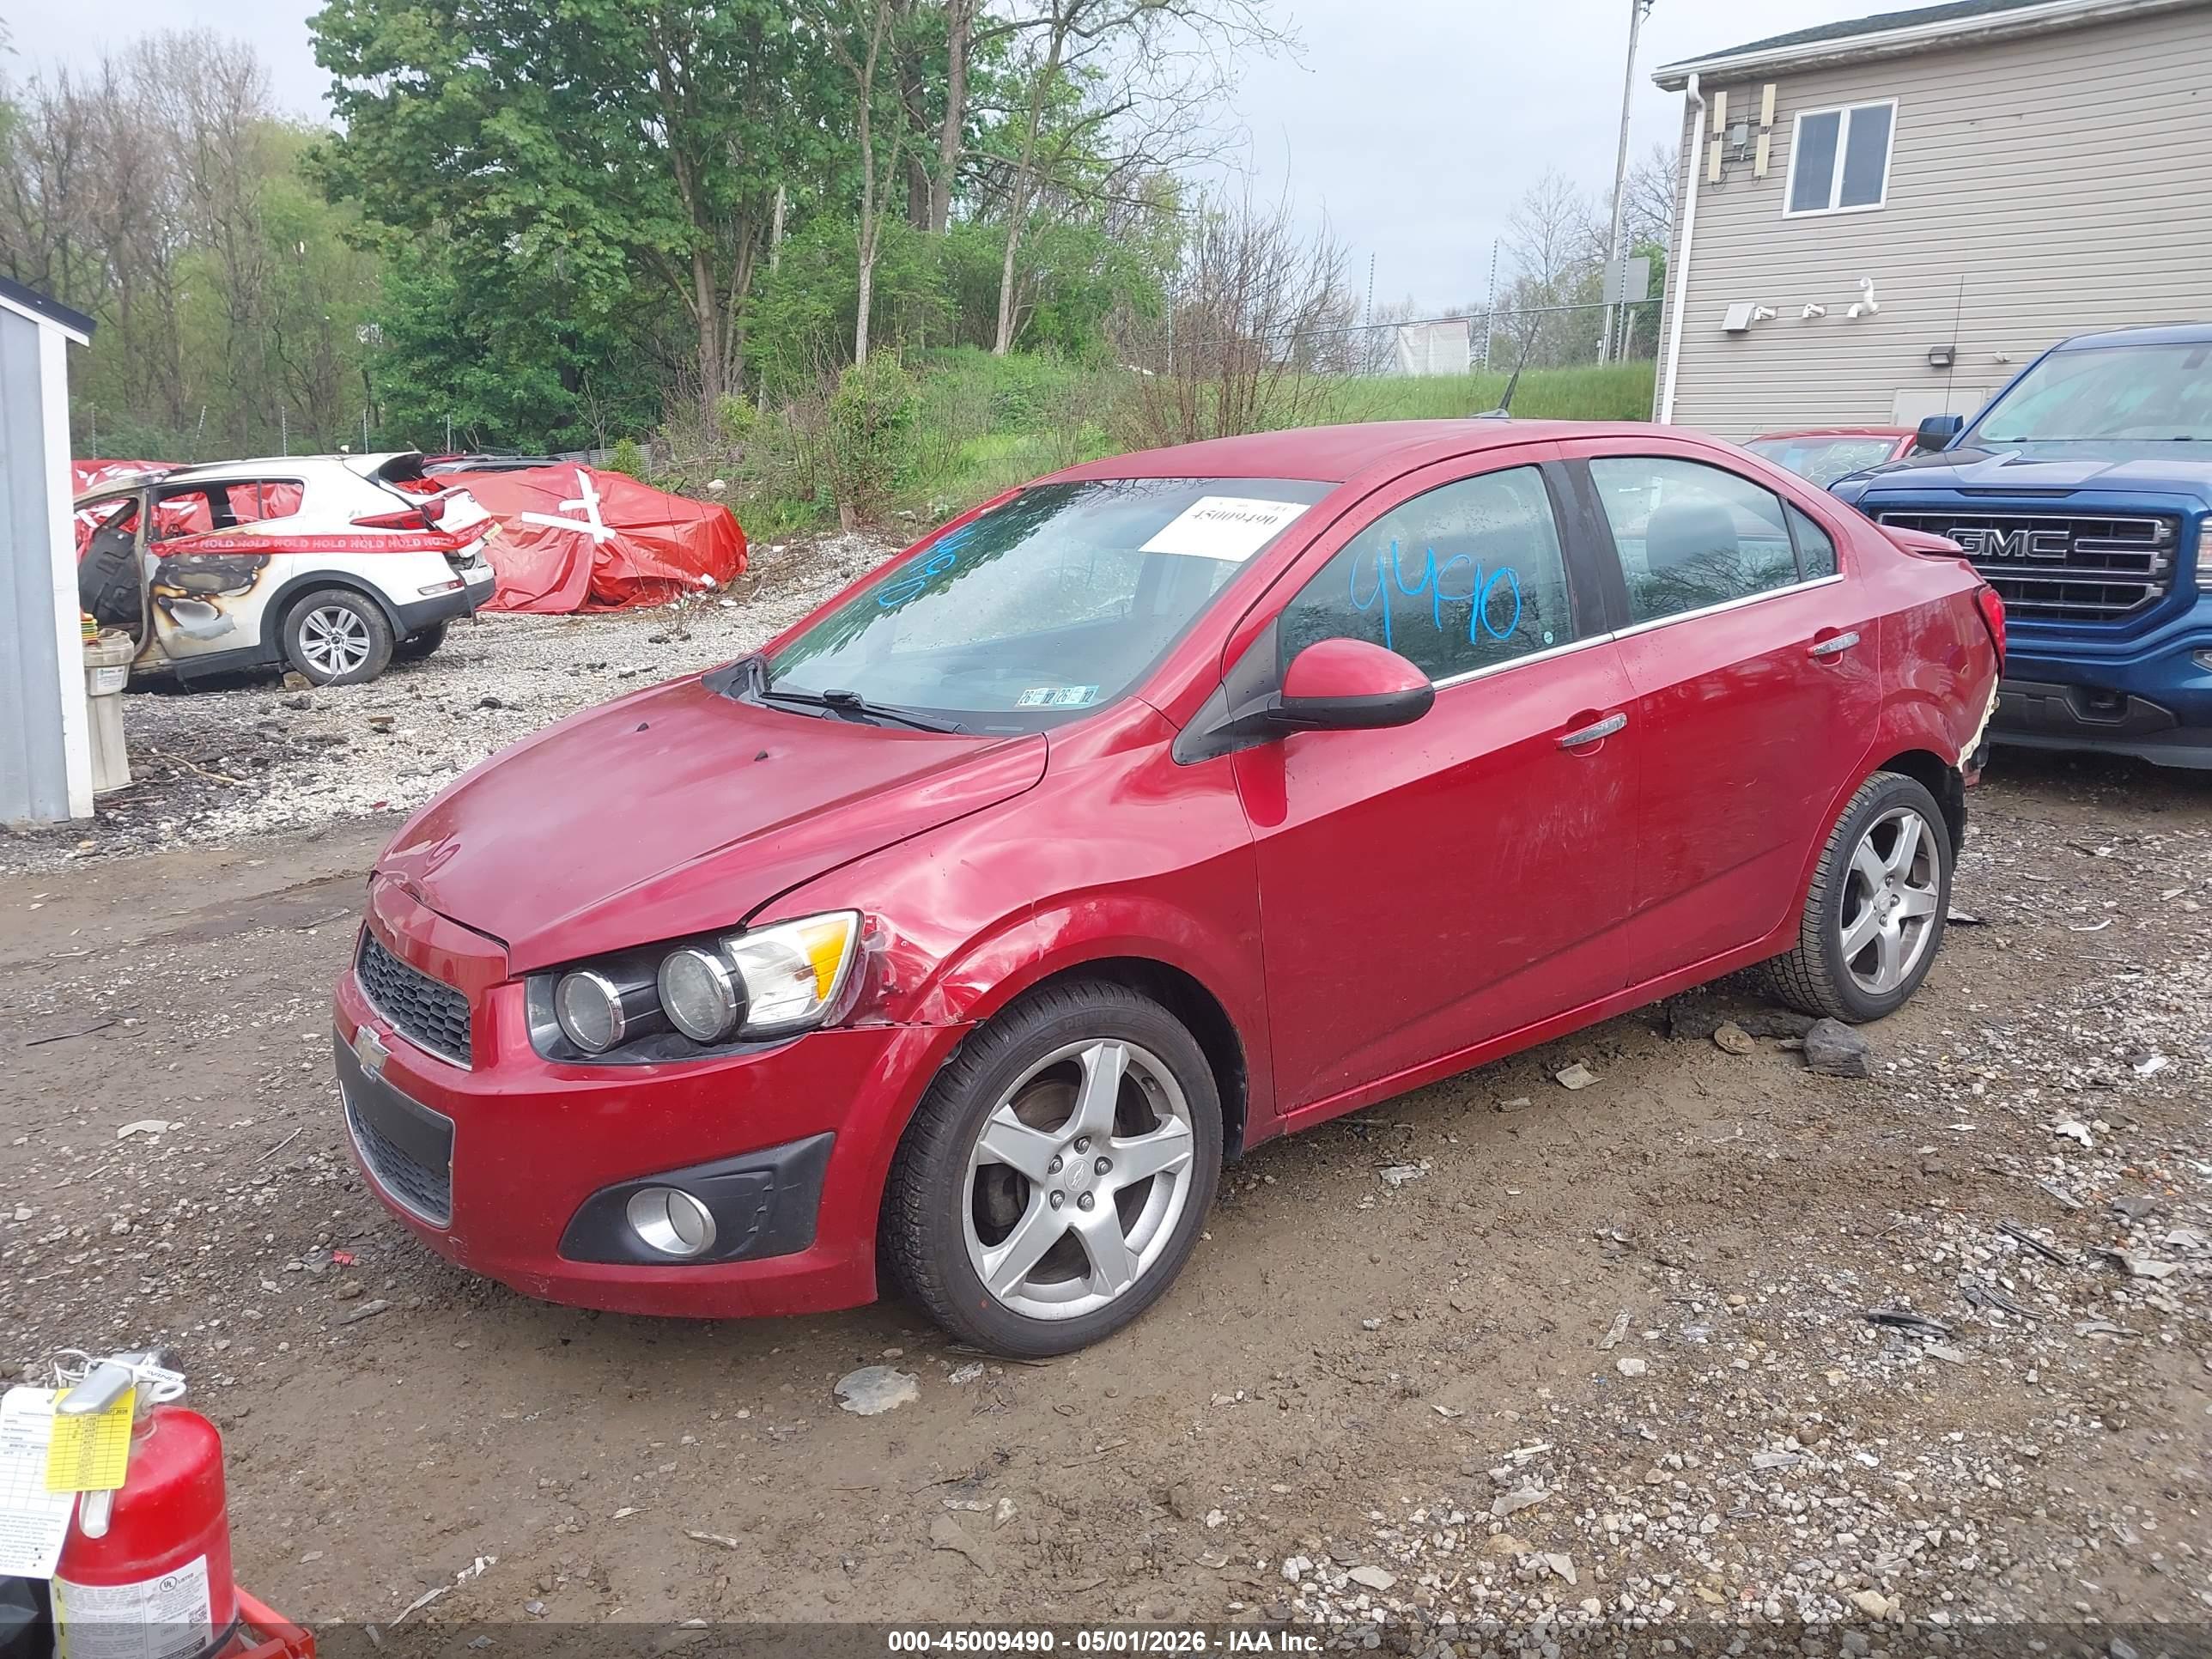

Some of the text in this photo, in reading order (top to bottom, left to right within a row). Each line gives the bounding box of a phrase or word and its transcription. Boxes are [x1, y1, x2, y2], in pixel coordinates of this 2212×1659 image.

[200, 538, 234, 548] HOLD
[313, 539, 347, 549] HOLD
[349, 538, 385, 549] HOLD
[387, 537, 421, 548] HOLD
[1947, 527, 2070, 559] GMC
[1019, 690, 1034, 704] 26
[1056, 689, 1072, 702] 26
